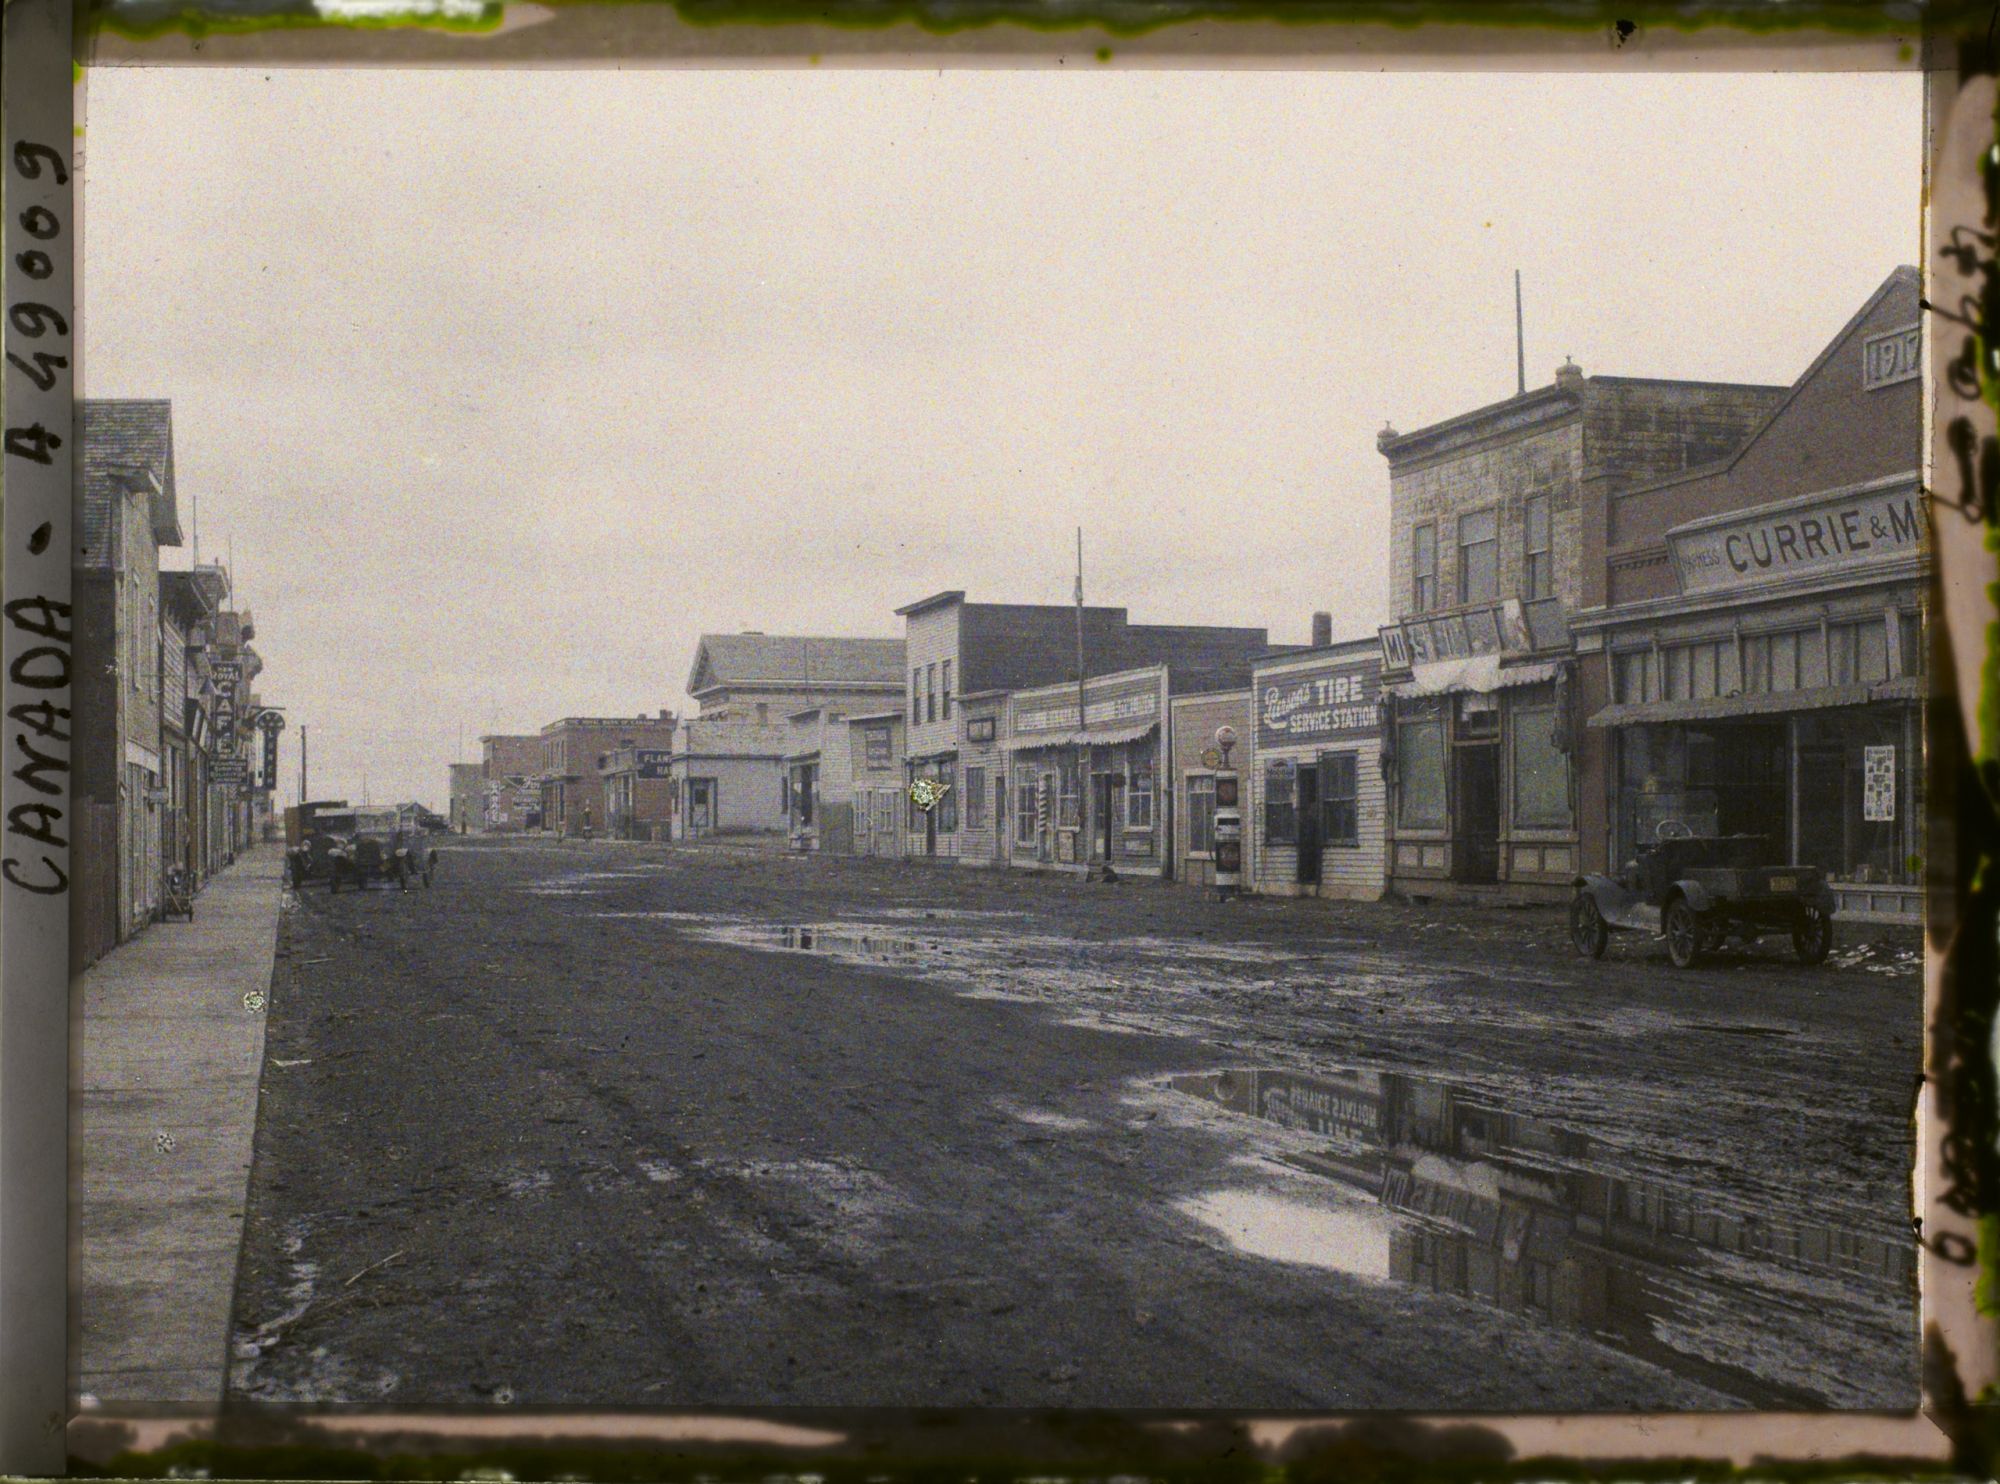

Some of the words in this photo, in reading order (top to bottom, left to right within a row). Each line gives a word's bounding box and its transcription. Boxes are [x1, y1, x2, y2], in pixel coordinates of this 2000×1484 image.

[8, 140, 68, 391] 49009
[5, 423, 62, 465] A
[1725, 510, 1871, 573] CURRIE
[1870, 515, 1889, 540] &
[1315, 676, 1364, 706] TIRE
[1289, 709, 1332, 734] SERVICE
[1331, 704, 1379, 730] STATION
[3, 597, 71, 895] CANADA
